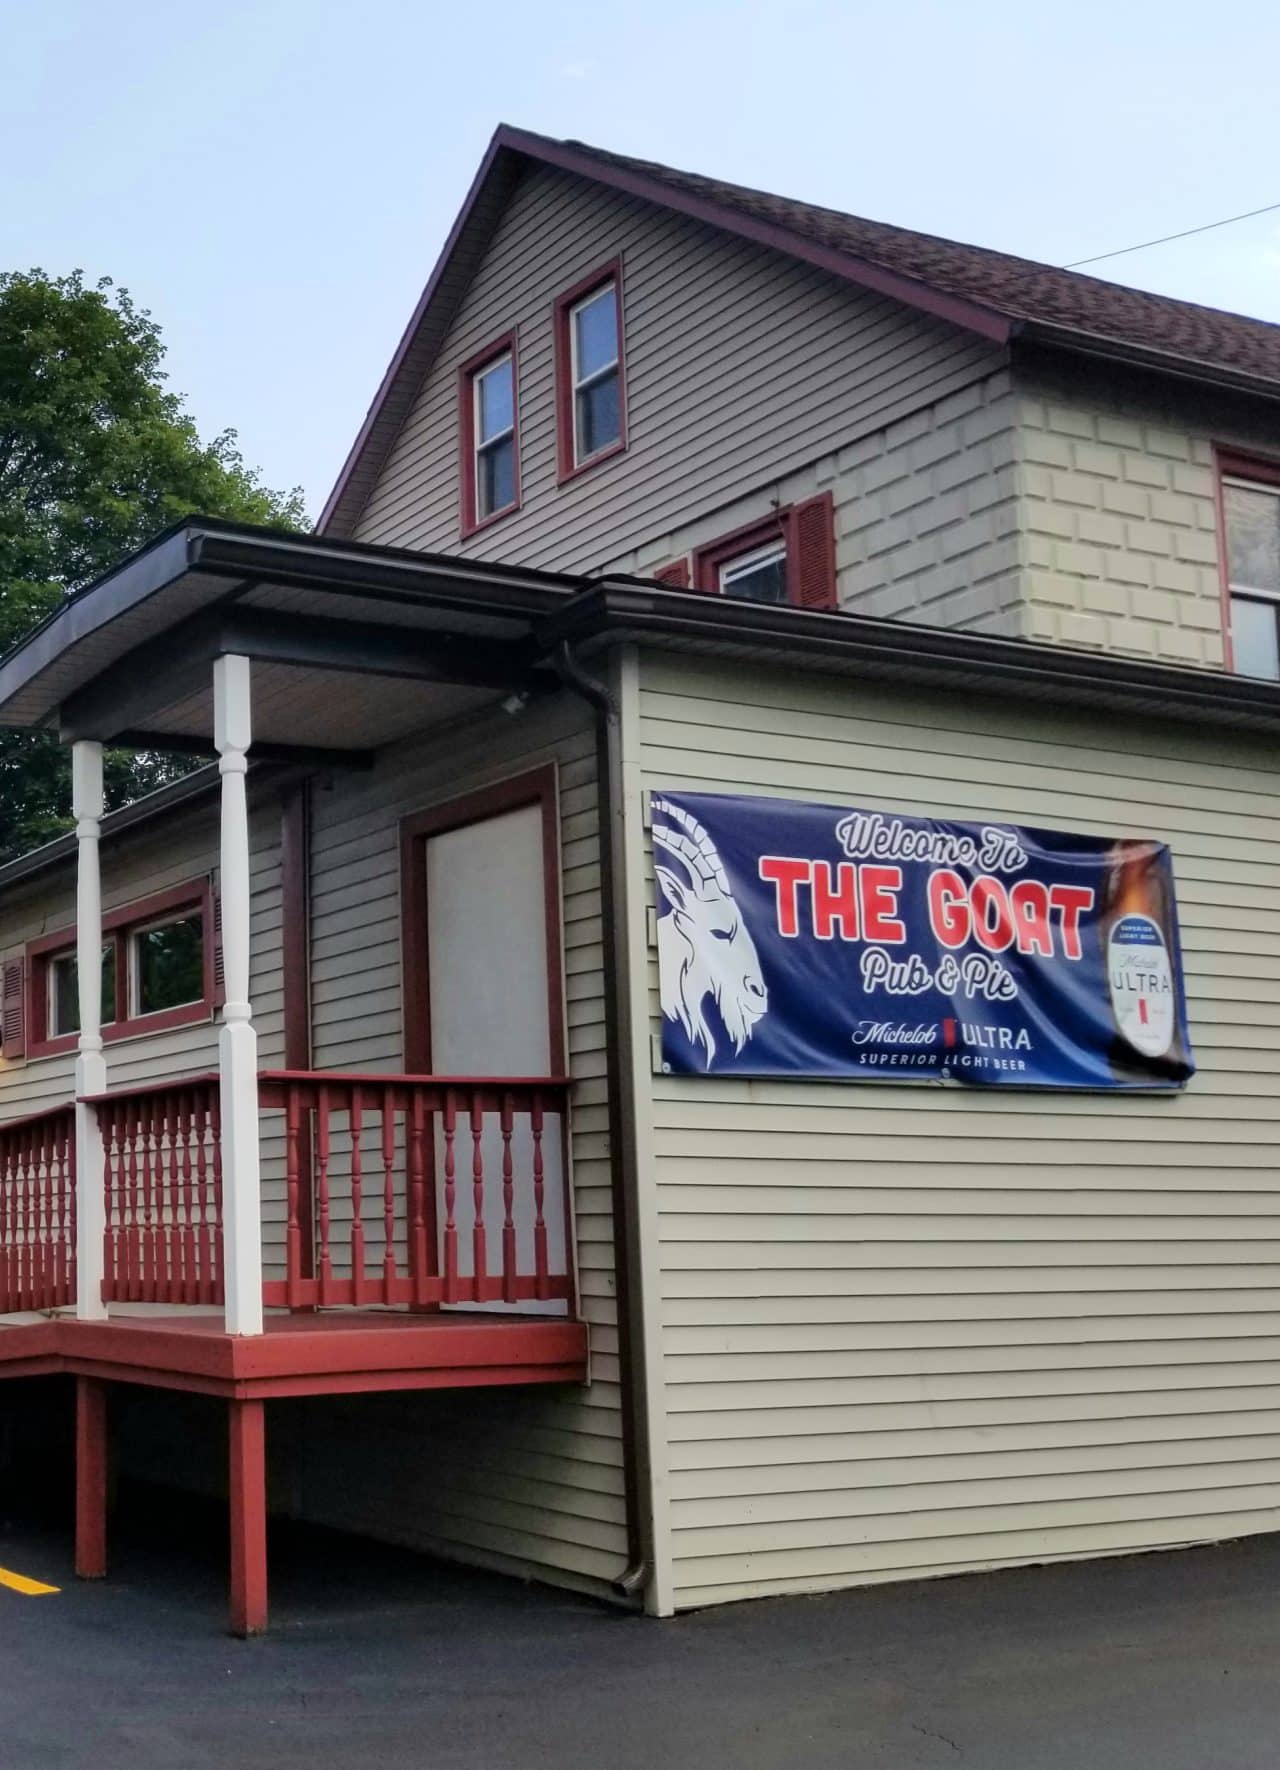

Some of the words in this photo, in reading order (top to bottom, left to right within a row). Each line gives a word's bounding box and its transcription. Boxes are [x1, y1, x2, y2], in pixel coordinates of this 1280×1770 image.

[836, 813, 977, 866] Welcome
[978, 826, 1029, 872] To
[758, 855, 906, 944] THE
[927, 868, 1094, 960] GOAT
[860, 946, 933, 995] Pub
[935, 954, 960, 995] &
[962, 953, 1018, 1001] Pie
[1113, 972, 1171, 993] ULTRA
[852, 1020, 939, 1045] Michelob
[961, 1023, 1033, 1050] ULTRA
[859, 1053, 937, 1065] SUPERIOR
[944, 1054, 989, 1068] LIGHT
[993, 1058, 1026, 1071] BEER
